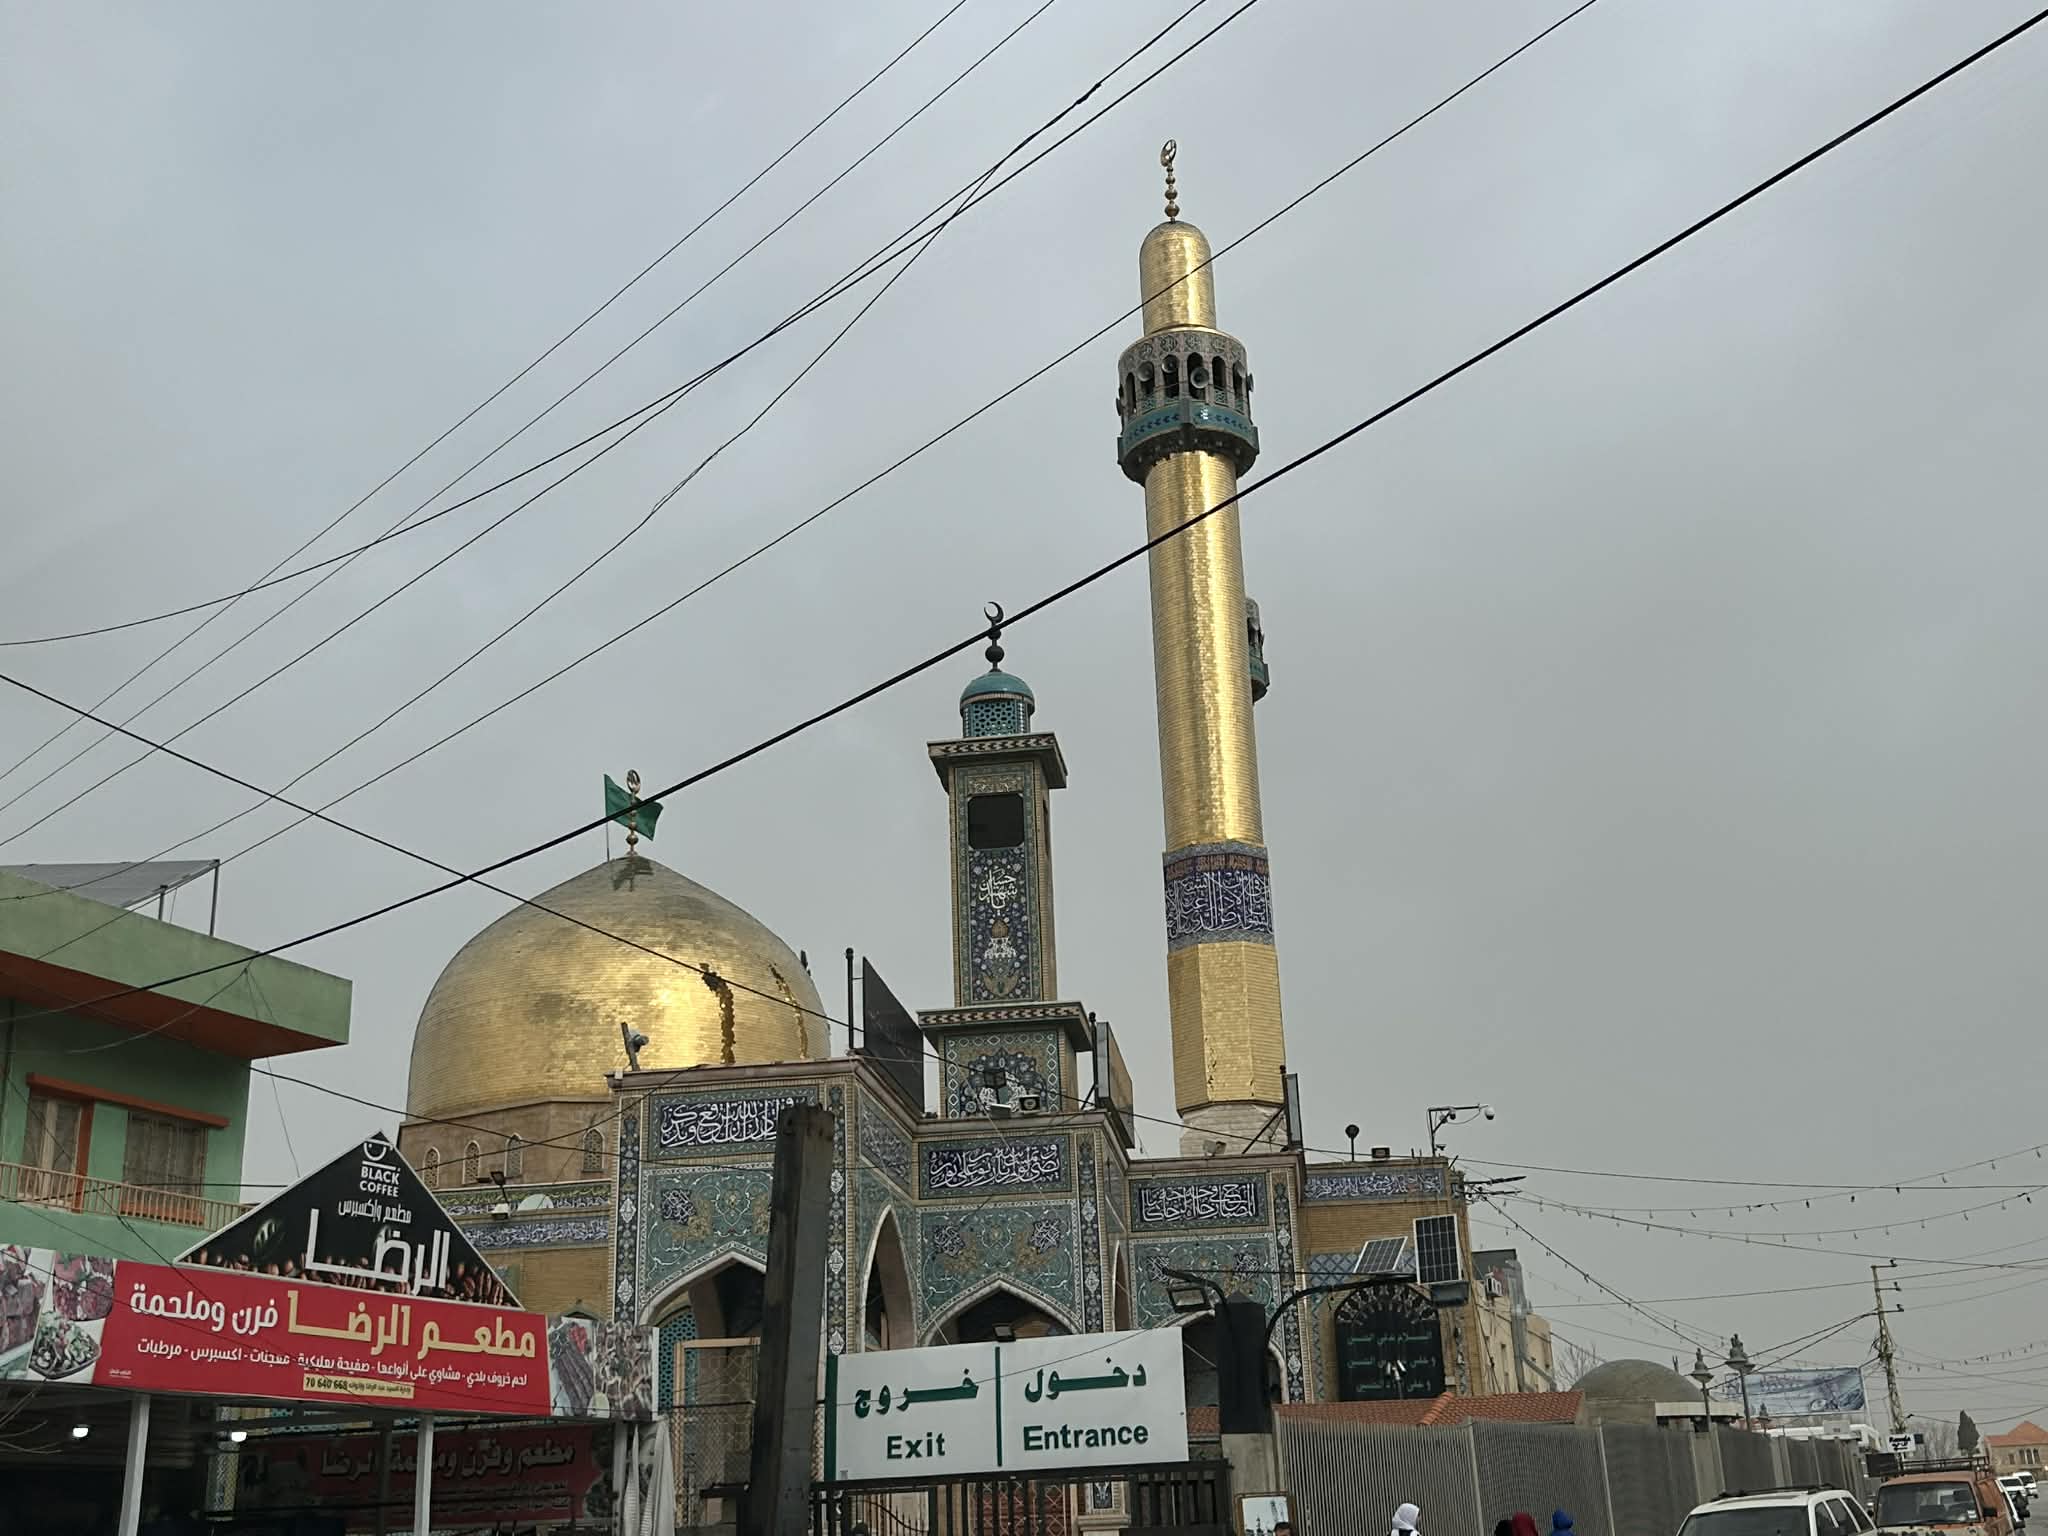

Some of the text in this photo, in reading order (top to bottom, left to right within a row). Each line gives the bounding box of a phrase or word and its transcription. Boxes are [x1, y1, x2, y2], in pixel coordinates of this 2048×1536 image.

[361, 1166, 400, 1185] BLACK
[360, 1180, 399, 1197] COFFEE
[383, 1203, 412, 1224] مطعم
[305, 1208, 450, 1297] الرضا
[130, 1283, 536, 1360] مطعم الرضا فرن وملحمة
[137, 1338, 182, 1360] مرطبات
[250, 1349, 290, 1367] معجنات
[337, 1356, 370, 1375] صفيحة
[410, 1365, 427, 1381] على
[429, 1365, 461, 1386] مشاوي
[305, 1377, 315, 1388] 70
[466, 1367, 486, 1389] بلدي
[487, 1371, 511, 1387] خروف
[510, 1373, 527, 1388] لحم
[1025, 1356, 1147, 1403] دخول
[854, 1368, 979, 1418] خروج
[887, 1432, 946, 1460] Exit
[1023, 1423, 1149, 1451] Entrance
